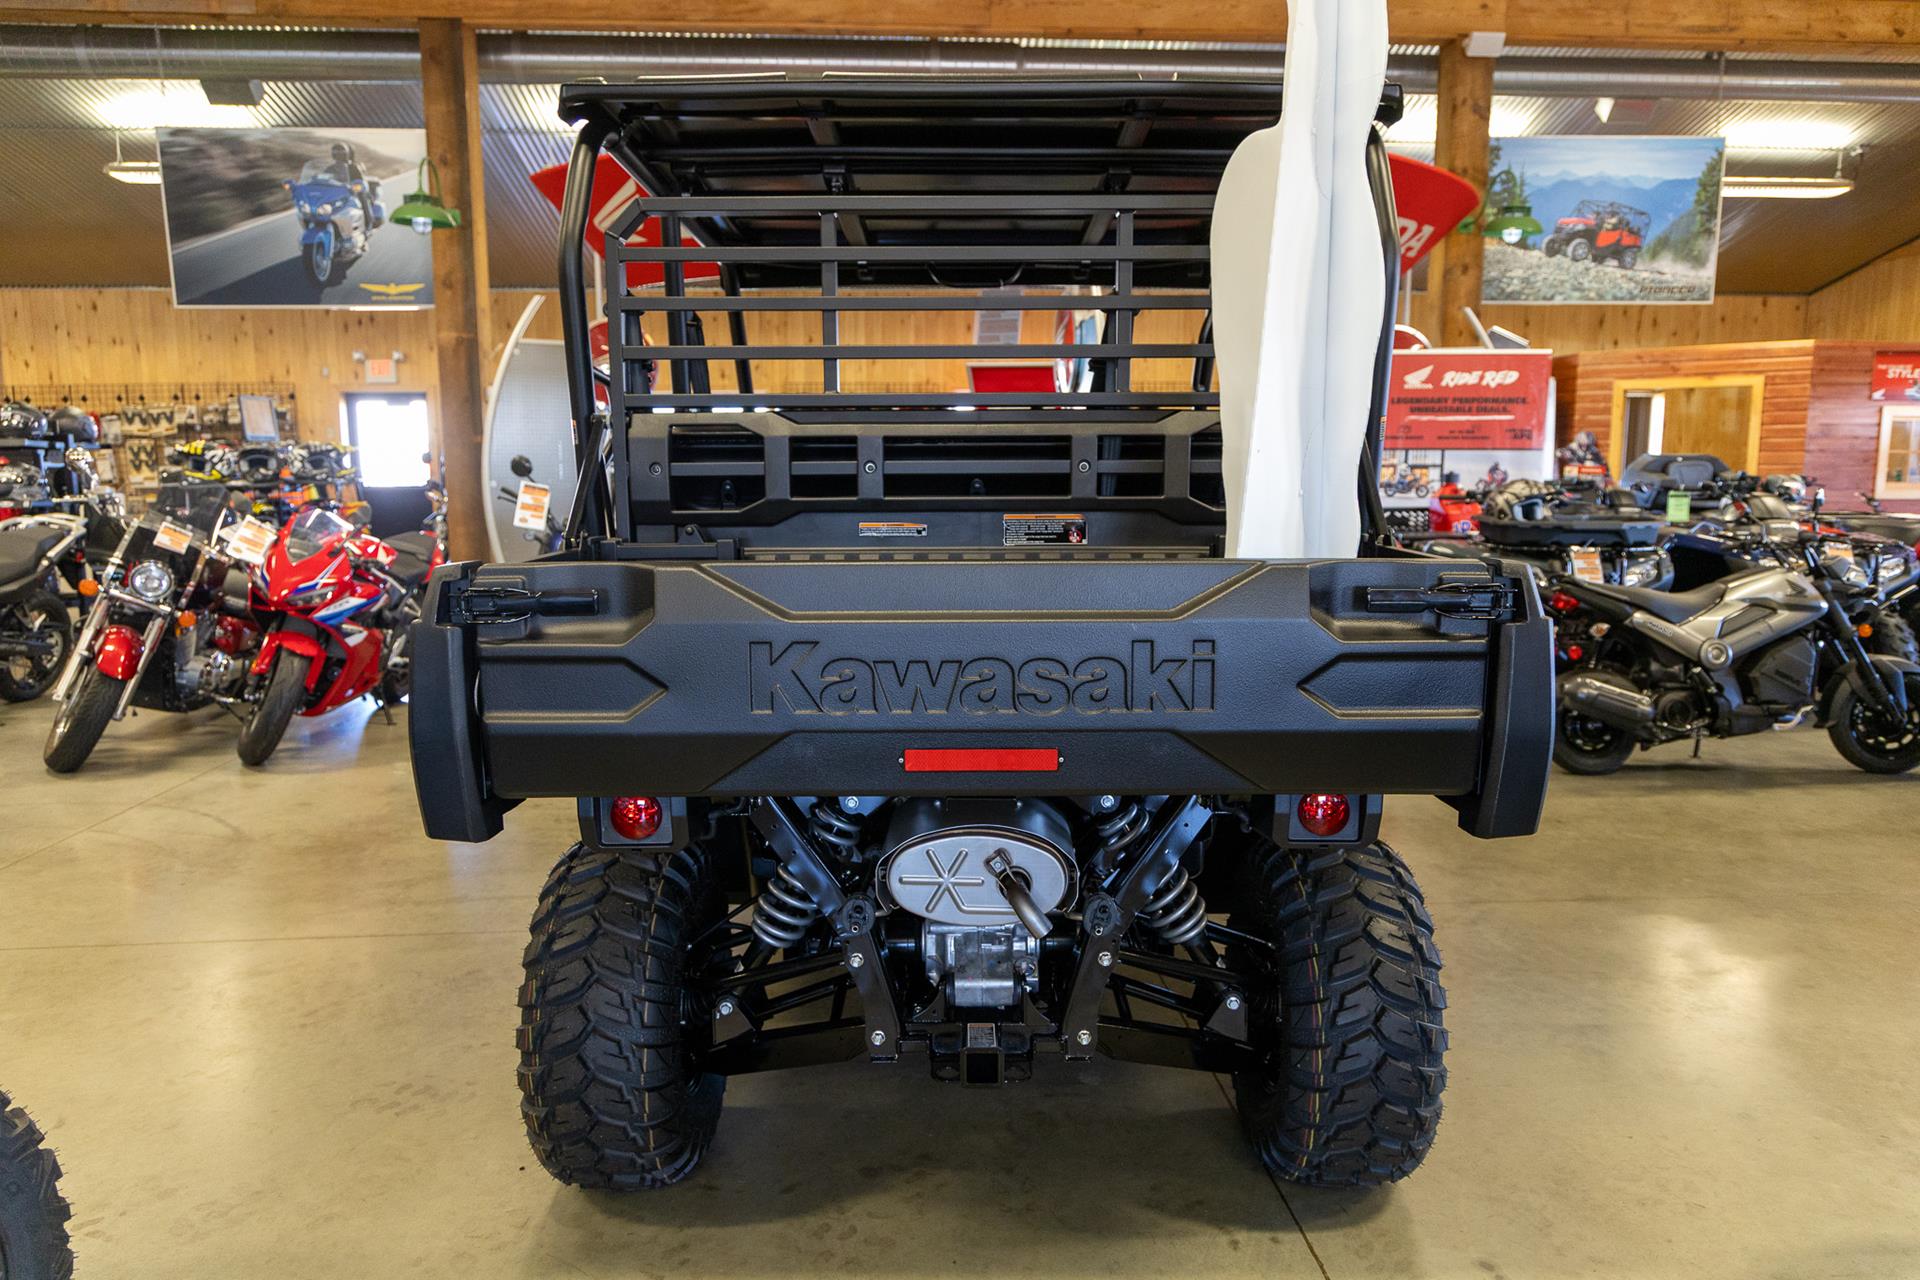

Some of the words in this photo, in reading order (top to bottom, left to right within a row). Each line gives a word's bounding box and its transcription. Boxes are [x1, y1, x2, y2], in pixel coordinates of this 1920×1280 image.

[1440, 370, 1483, 389] RIDE
[1481, 370, 1520, 389] RED
[748, 639, 1217, 716] Kawasaki
